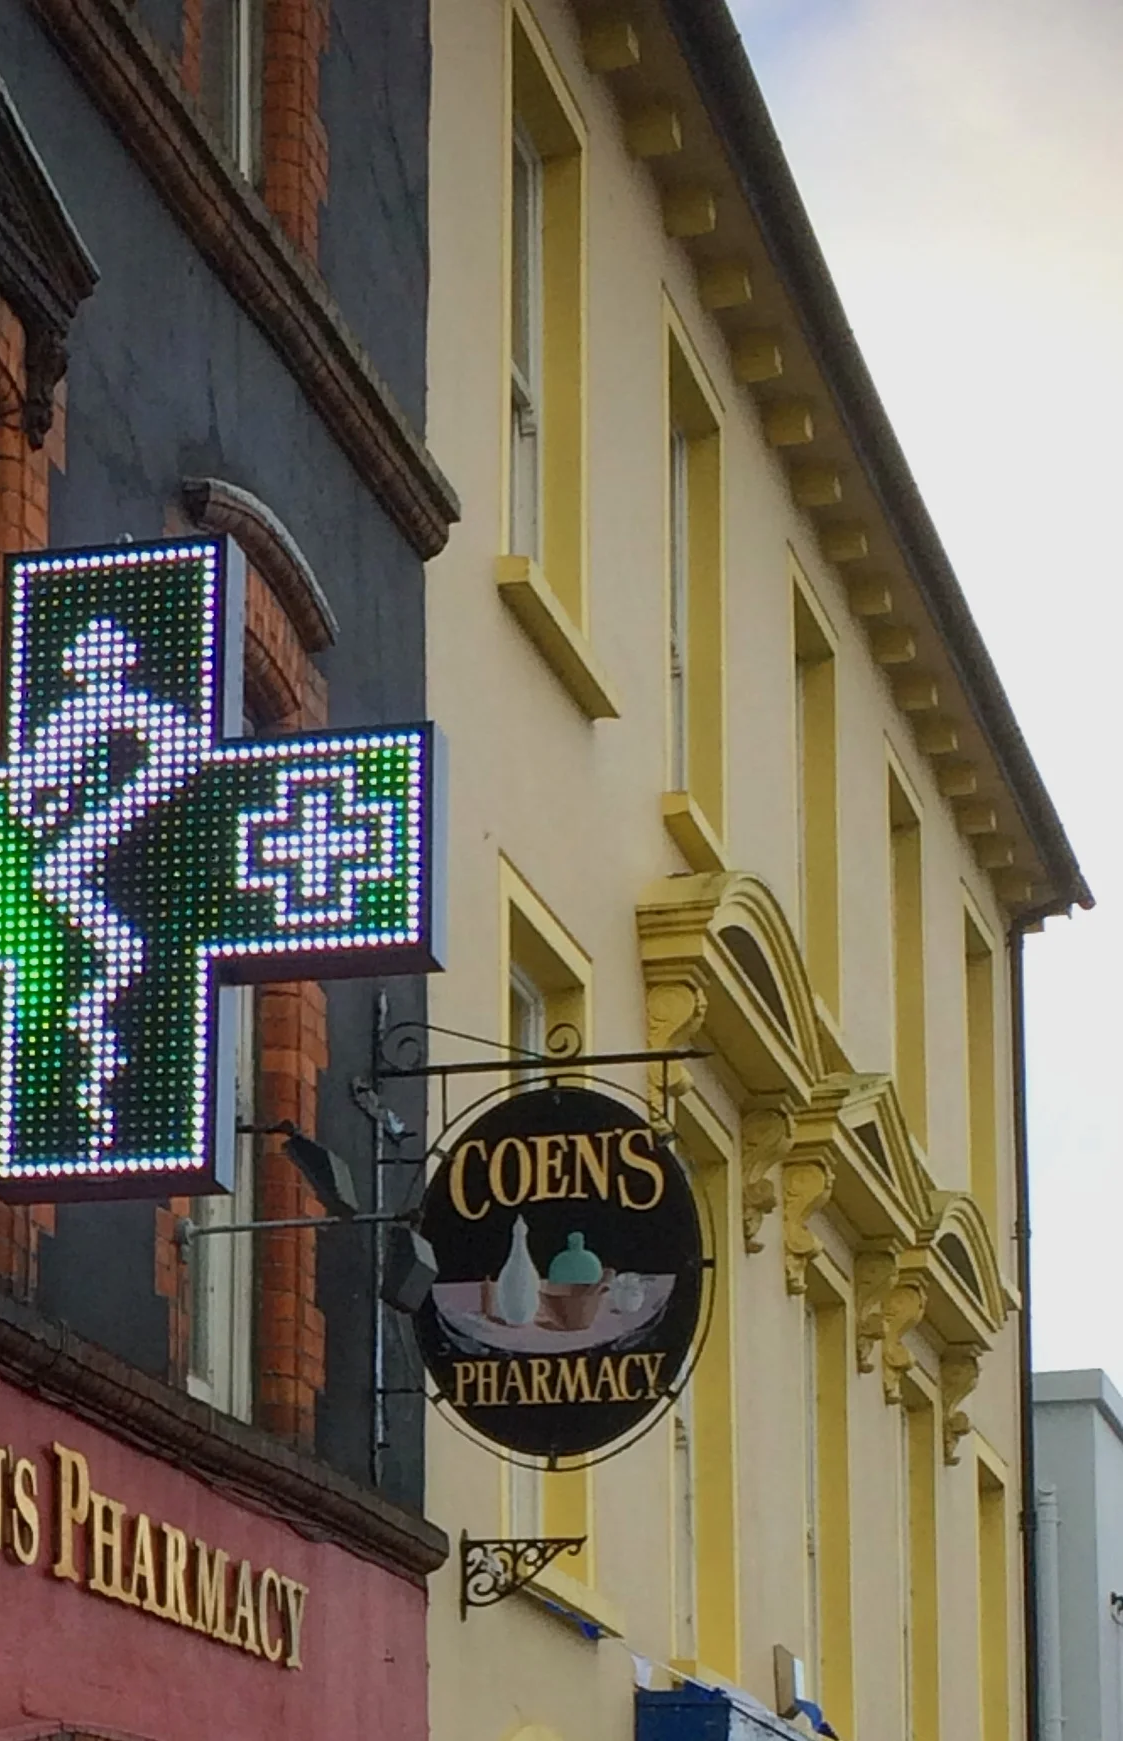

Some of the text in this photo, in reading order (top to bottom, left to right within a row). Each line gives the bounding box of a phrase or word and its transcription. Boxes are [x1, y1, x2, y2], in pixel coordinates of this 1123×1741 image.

[448, 1126, 665, 1221] COEN'S
[452, 1353, 667, 1407] PHARMACY
[53, 1441, 309, 1670] PHARMACY
